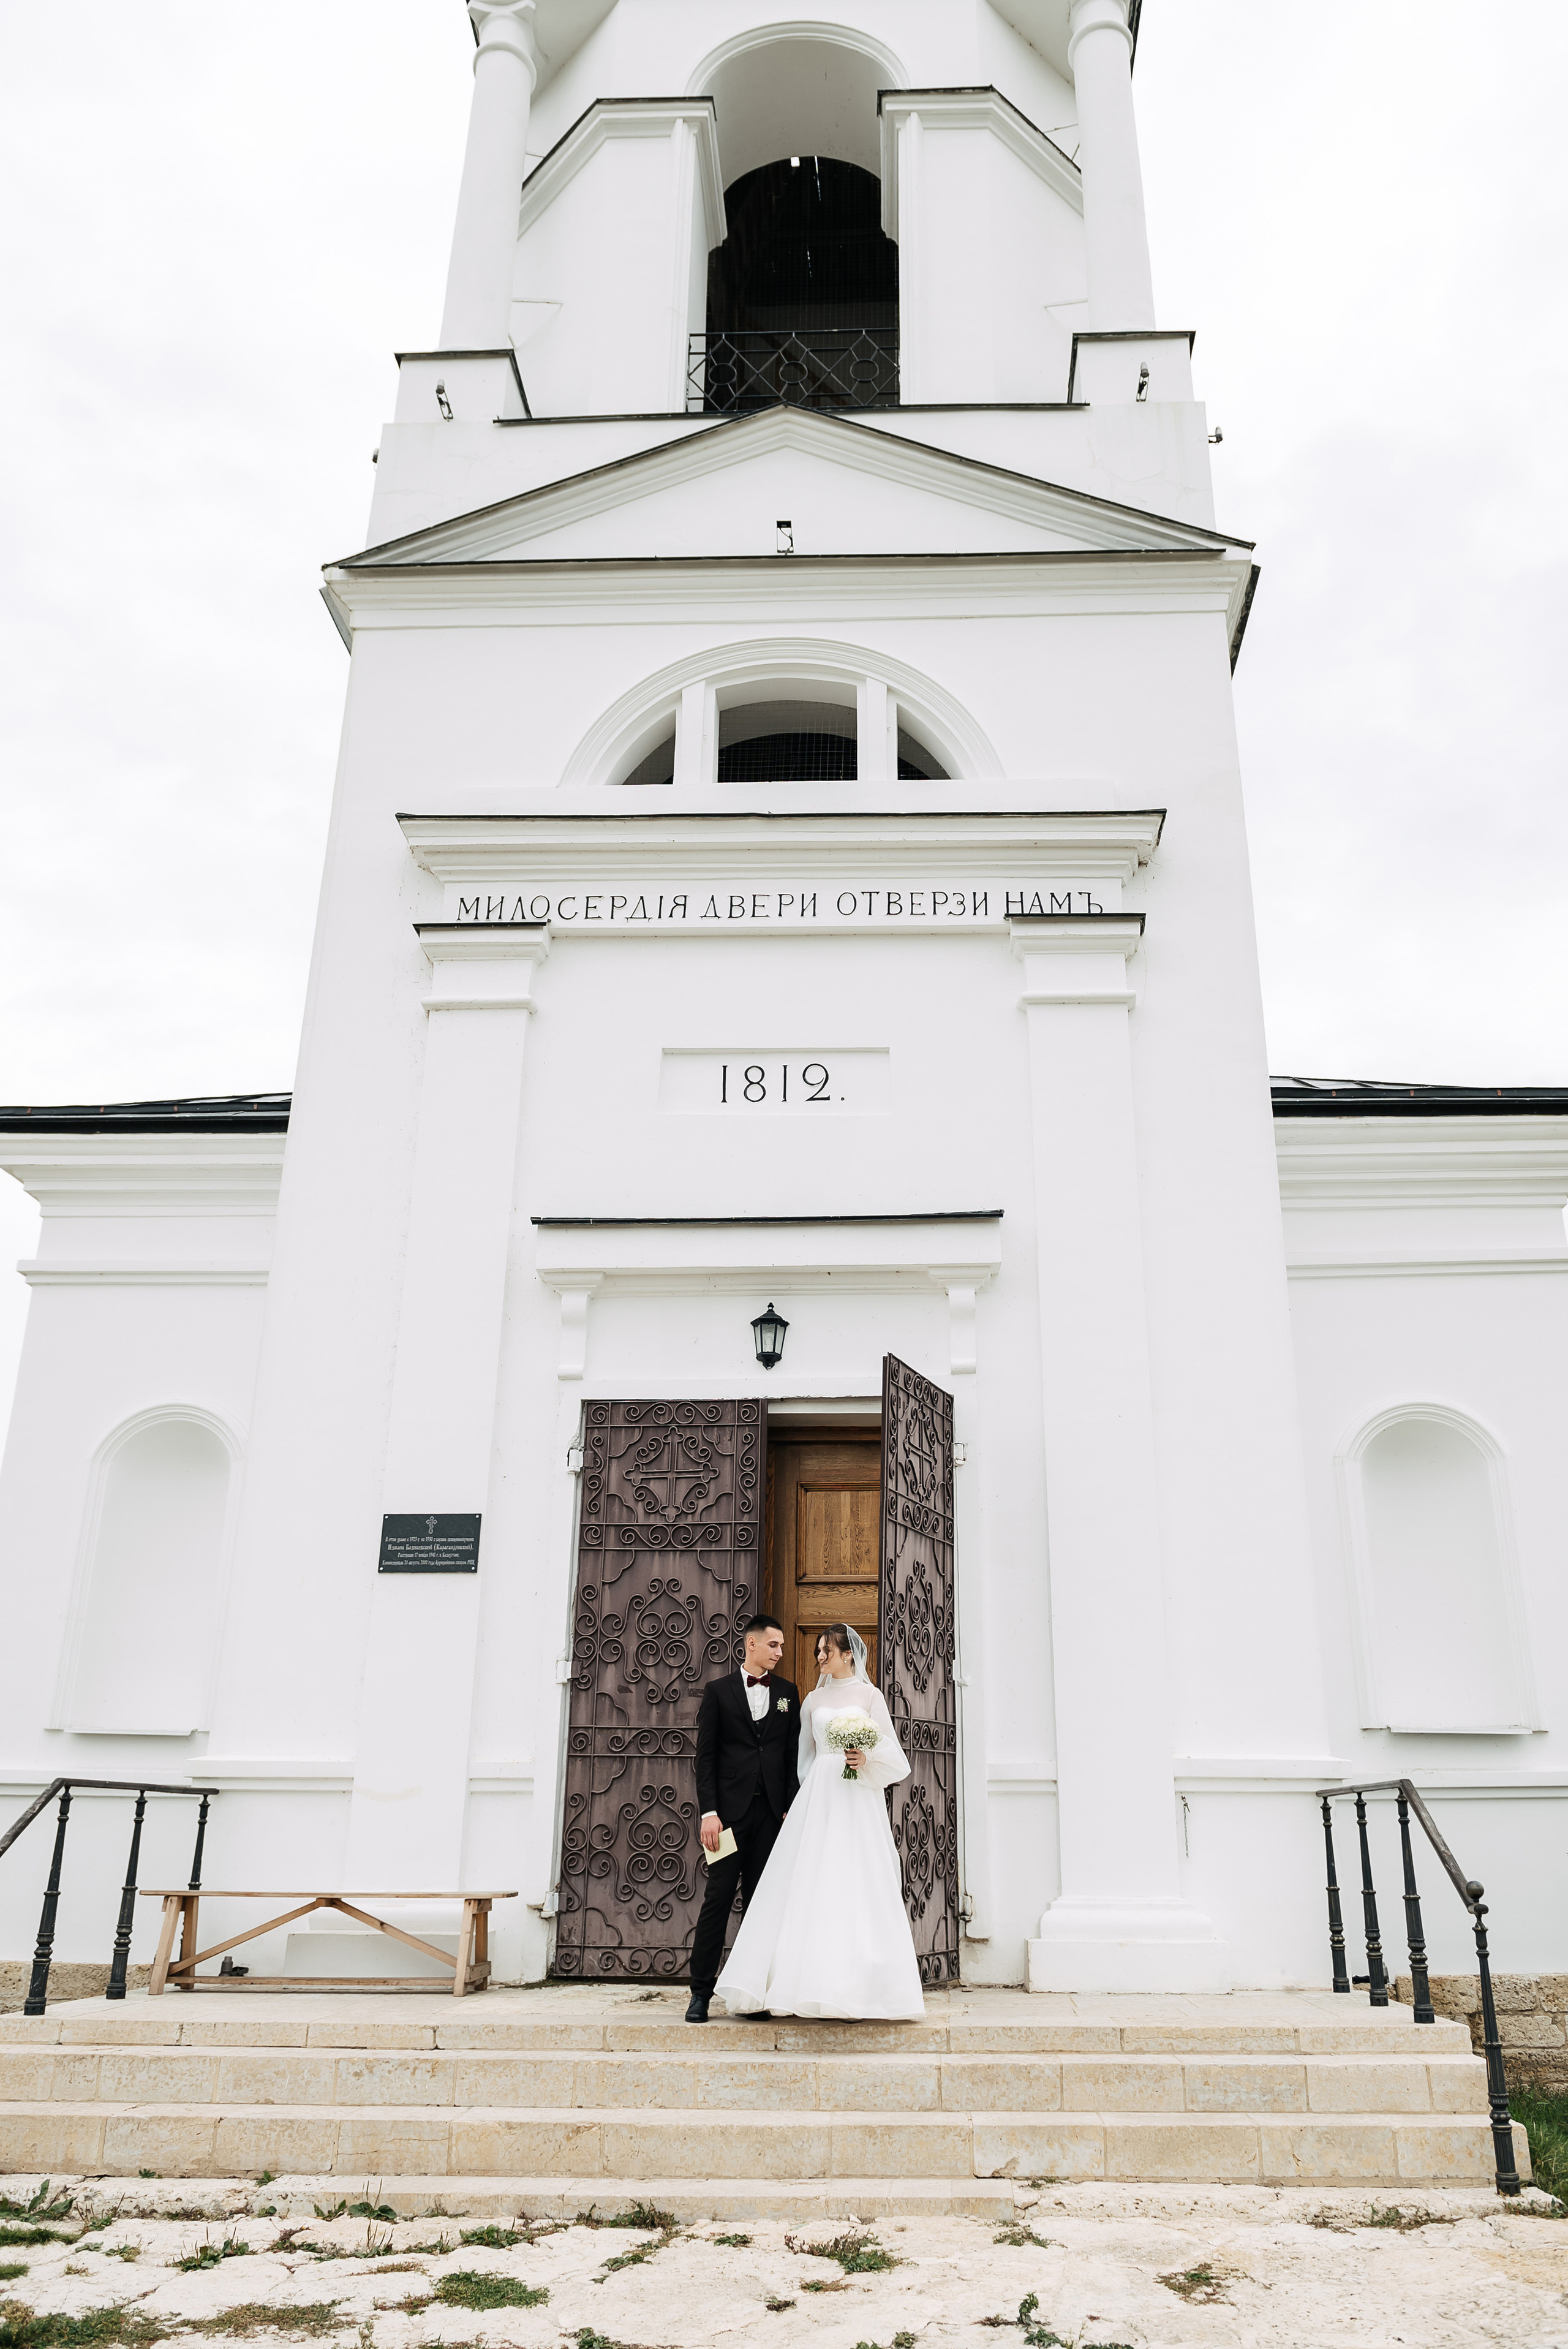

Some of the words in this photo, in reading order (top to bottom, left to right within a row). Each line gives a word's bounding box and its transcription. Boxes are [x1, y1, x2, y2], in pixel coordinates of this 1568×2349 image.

[457, 895, 688, 922] МИЛОСЕРДІЯ
[700, 893, 817, 919] ДВЕРИ
[837, 891, 989, 916] ОТВЕРЗИ
[1005, 891, 1103, 914] НАМЪ
[720, 1063, 845, 1103] 1812.
